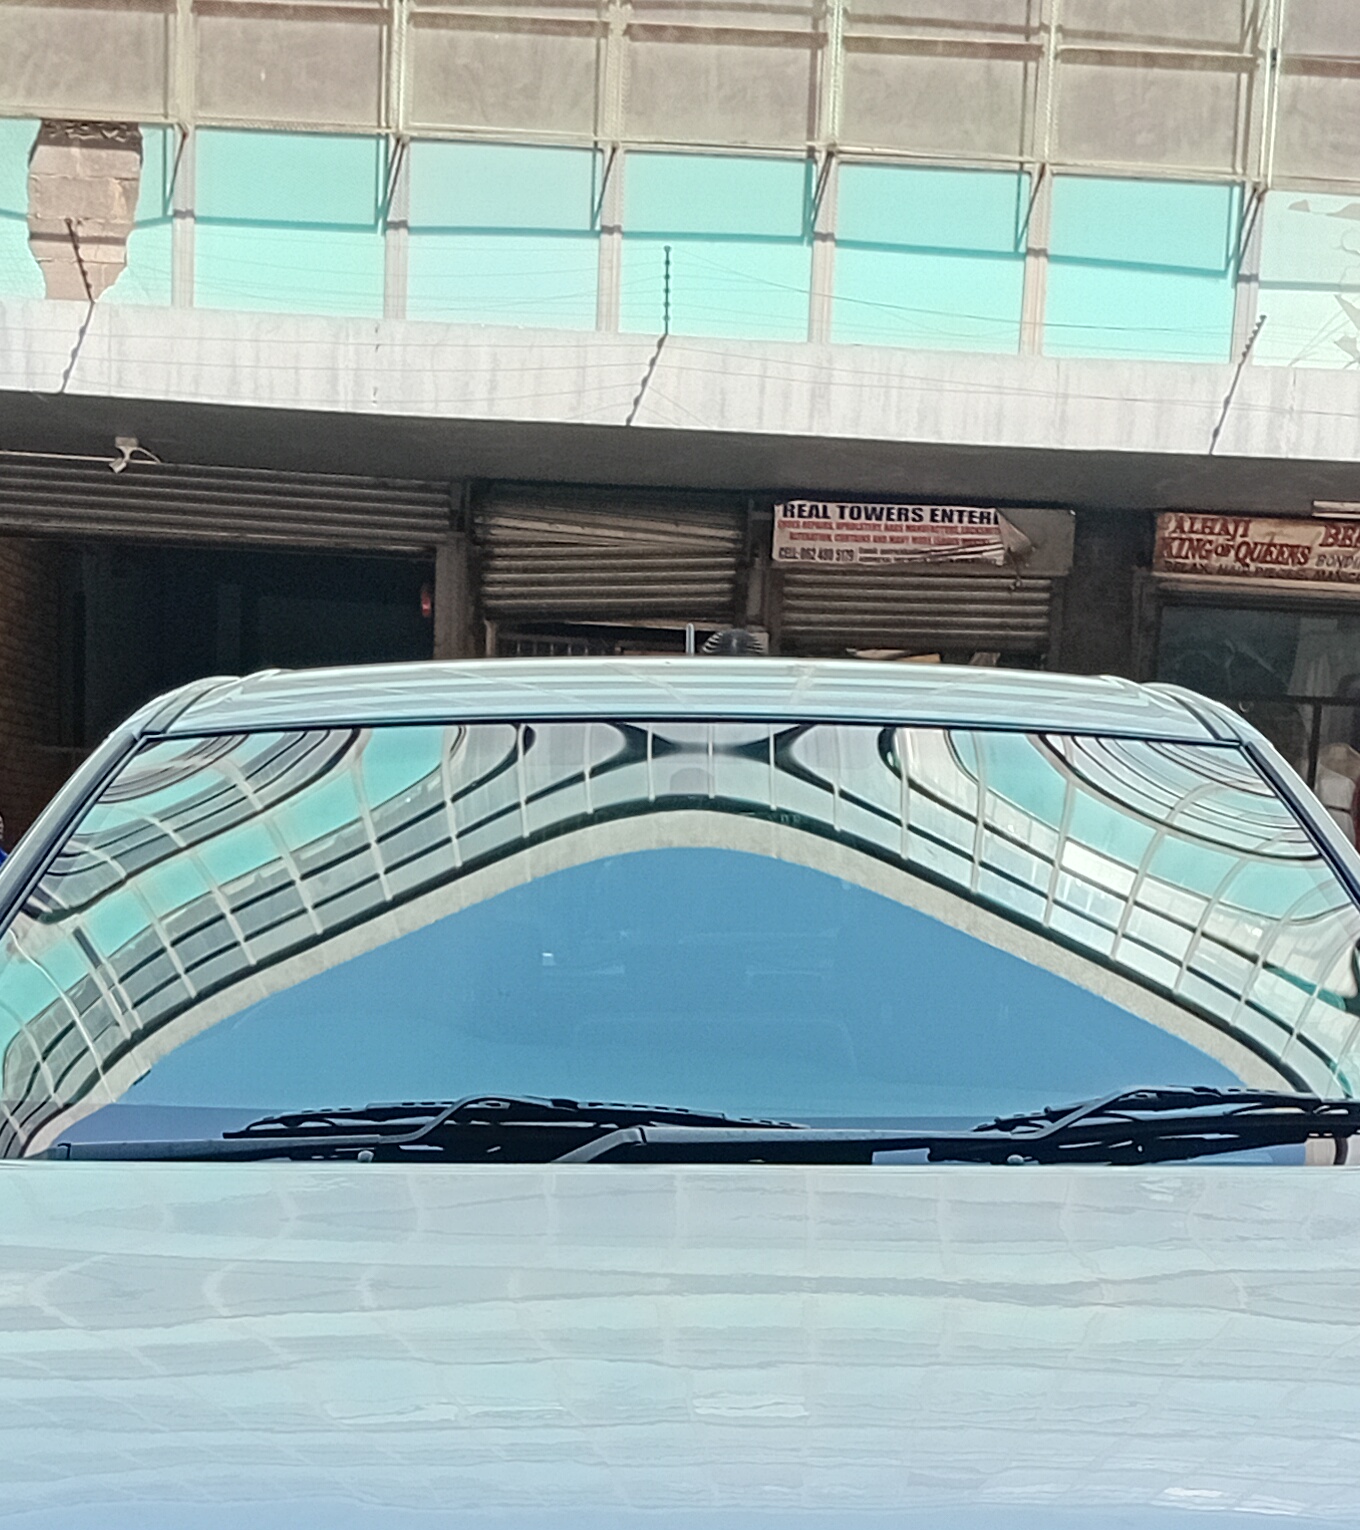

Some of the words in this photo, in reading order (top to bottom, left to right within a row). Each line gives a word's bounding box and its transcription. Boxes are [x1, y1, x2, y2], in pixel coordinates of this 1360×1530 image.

[783, 503, 831, 519] REAL
[836, 505, 924, 523] TOWERS
[1162, 536, 1213, 560] KING
[1234, 541, 1311, 566] QUEENS
